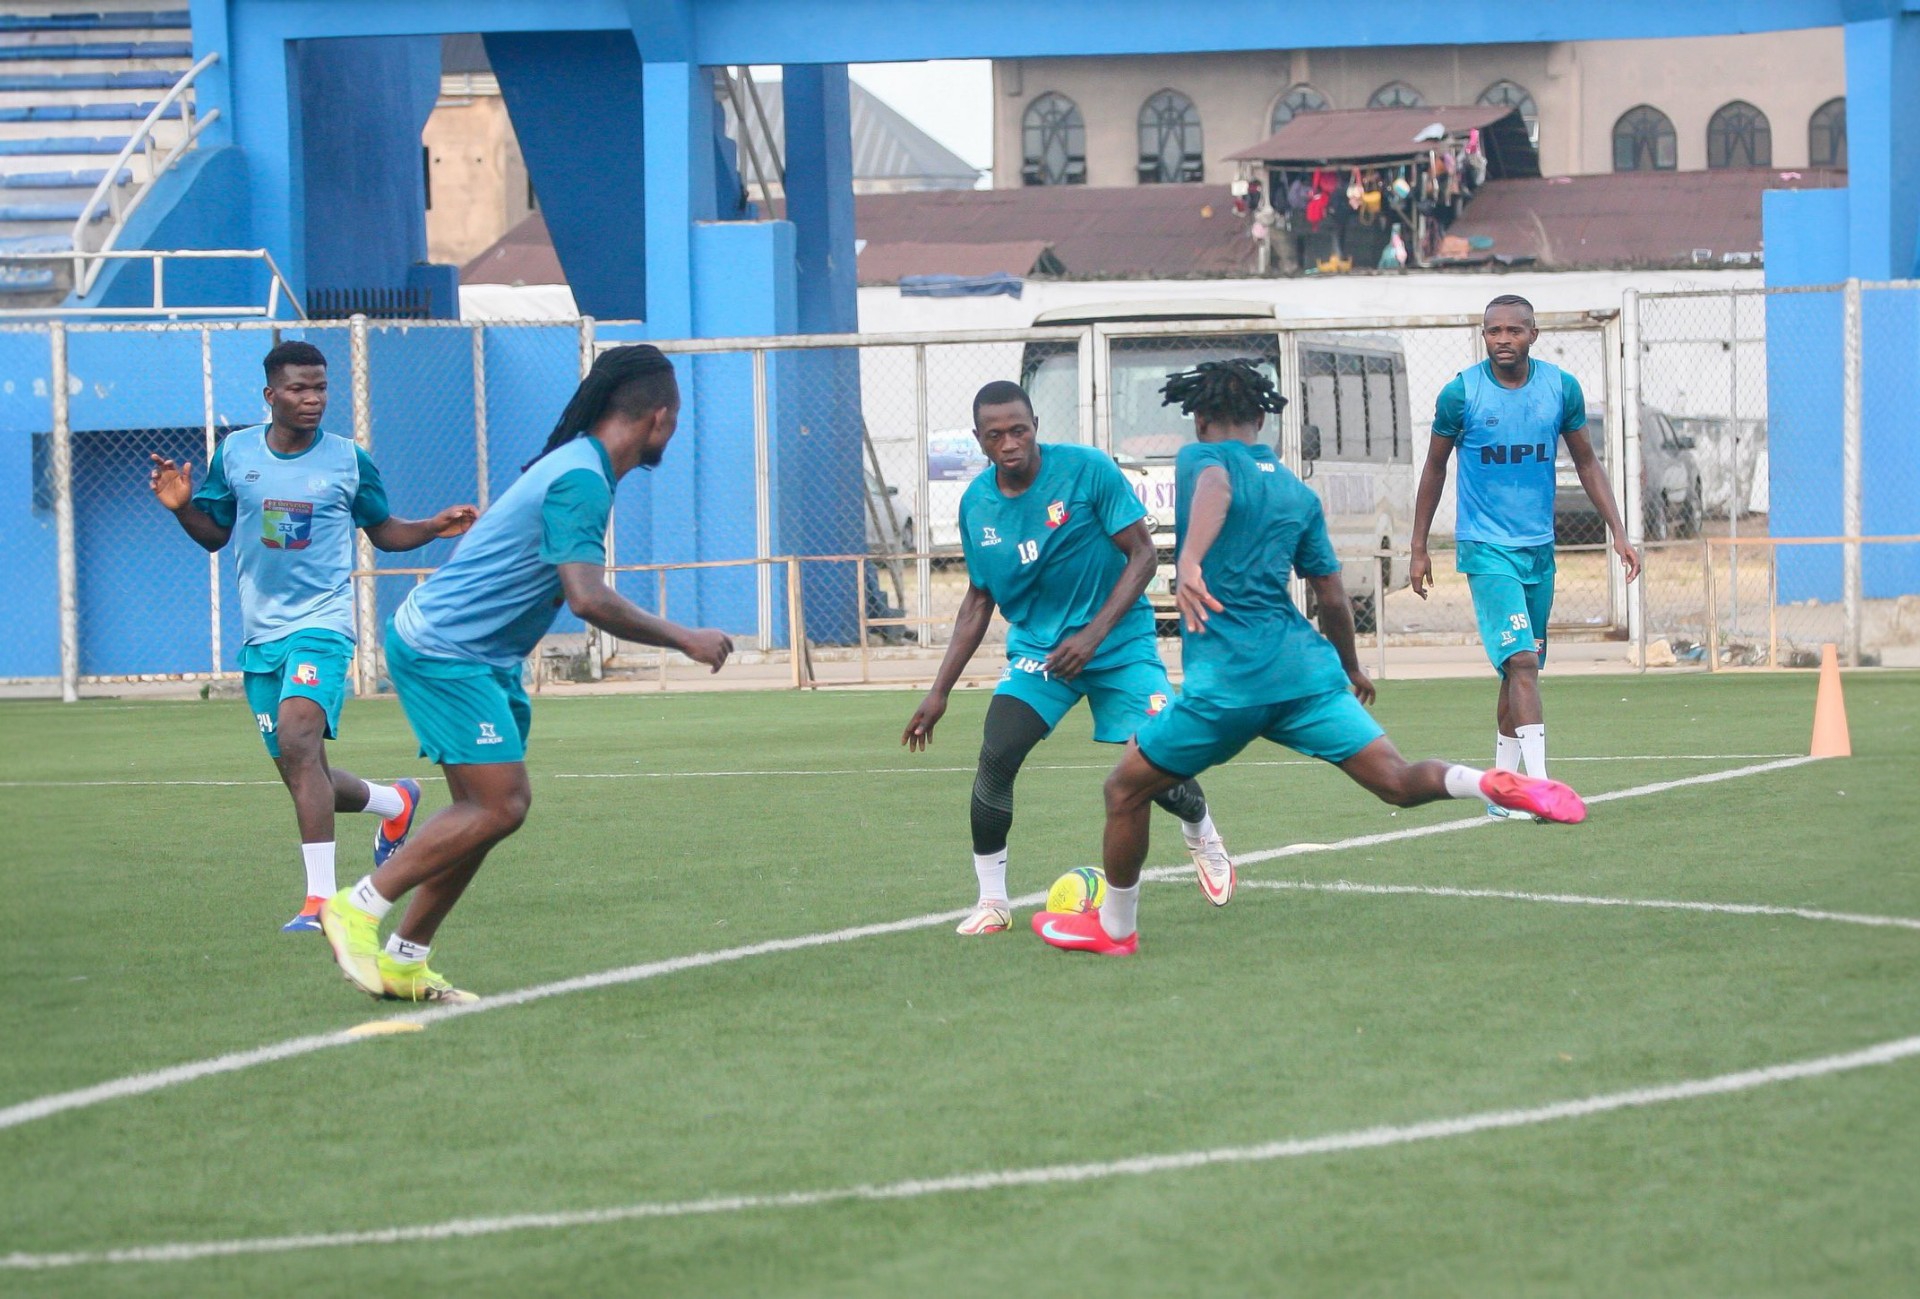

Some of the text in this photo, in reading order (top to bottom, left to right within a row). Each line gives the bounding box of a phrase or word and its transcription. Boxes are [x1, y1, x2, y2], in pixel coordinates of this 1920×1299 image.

[1480, 443, 1549, 464] NPL
[278, 522, 293, 532] 33
[1018, 540, 1039, 564] 18
[1510, 613, 1528, 630] 35
